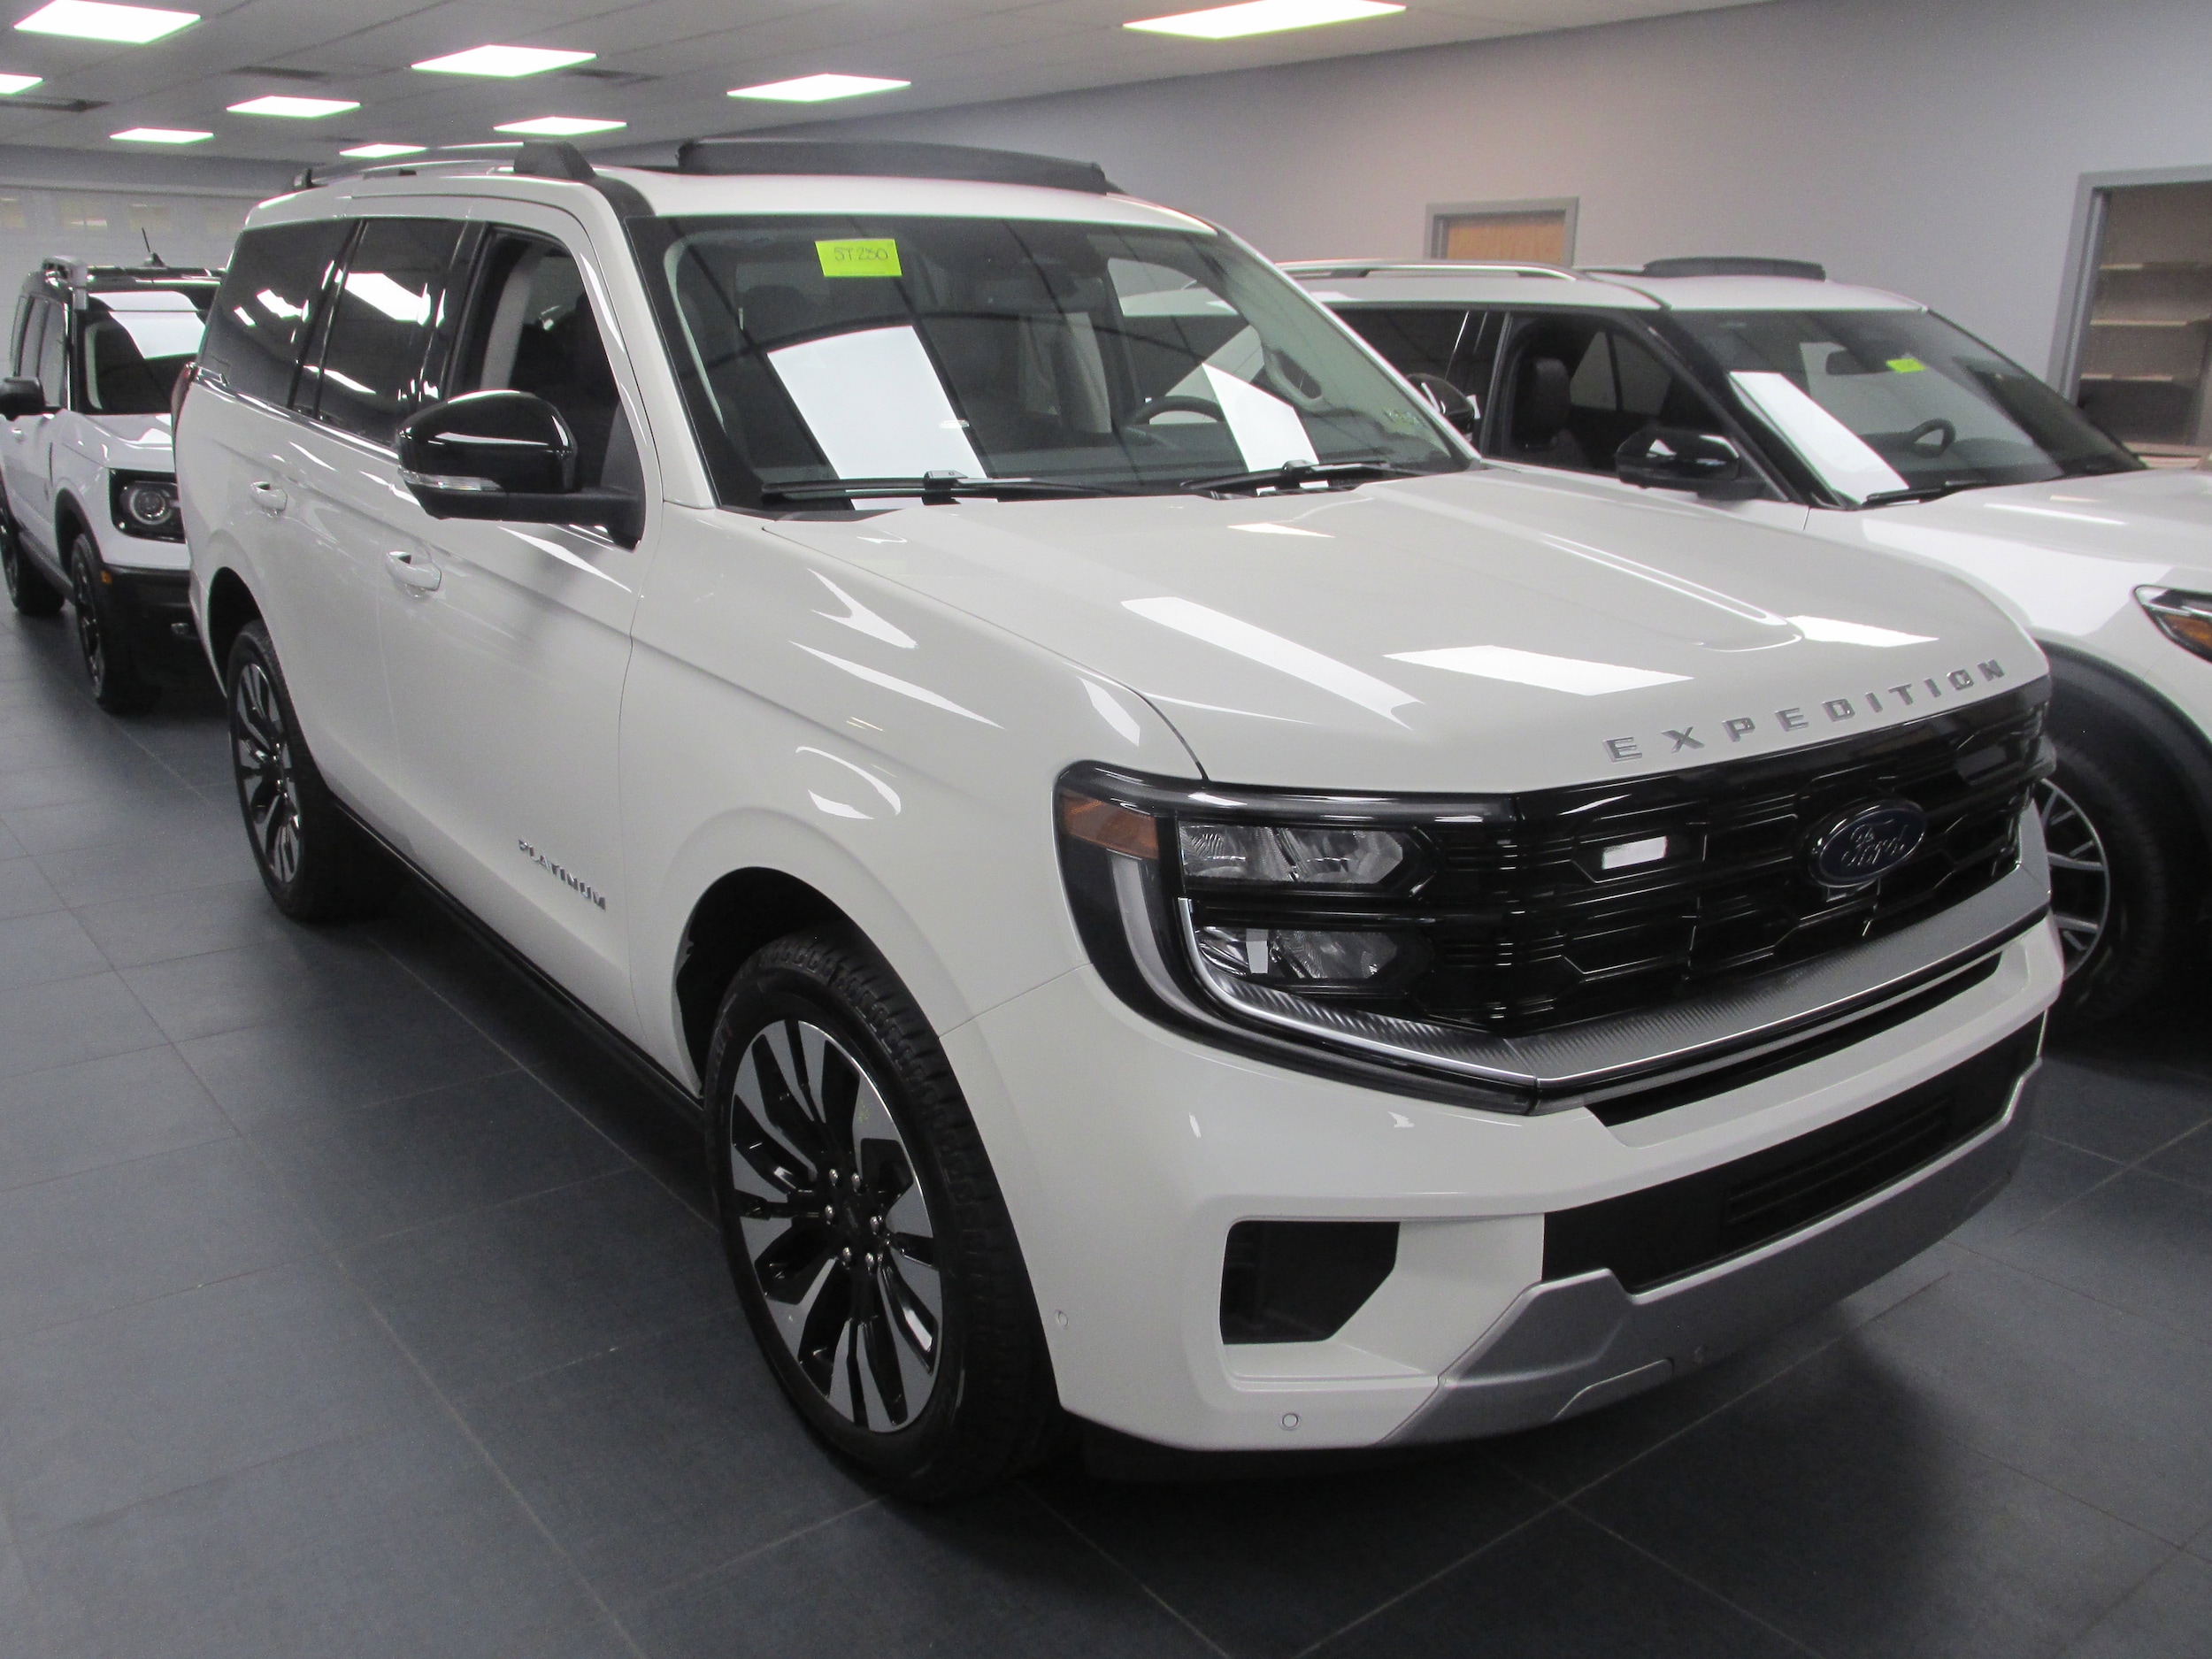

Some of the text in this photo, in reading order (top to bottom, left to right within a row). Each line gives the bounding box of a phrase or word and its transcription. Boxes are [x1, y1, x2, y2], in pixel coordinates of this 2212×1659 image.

[1602, 659, 2006, 763] EXPEDITION
[518, 839, 606, 911] PLATINUM
[1840, 818, 1909, 867] Ford
